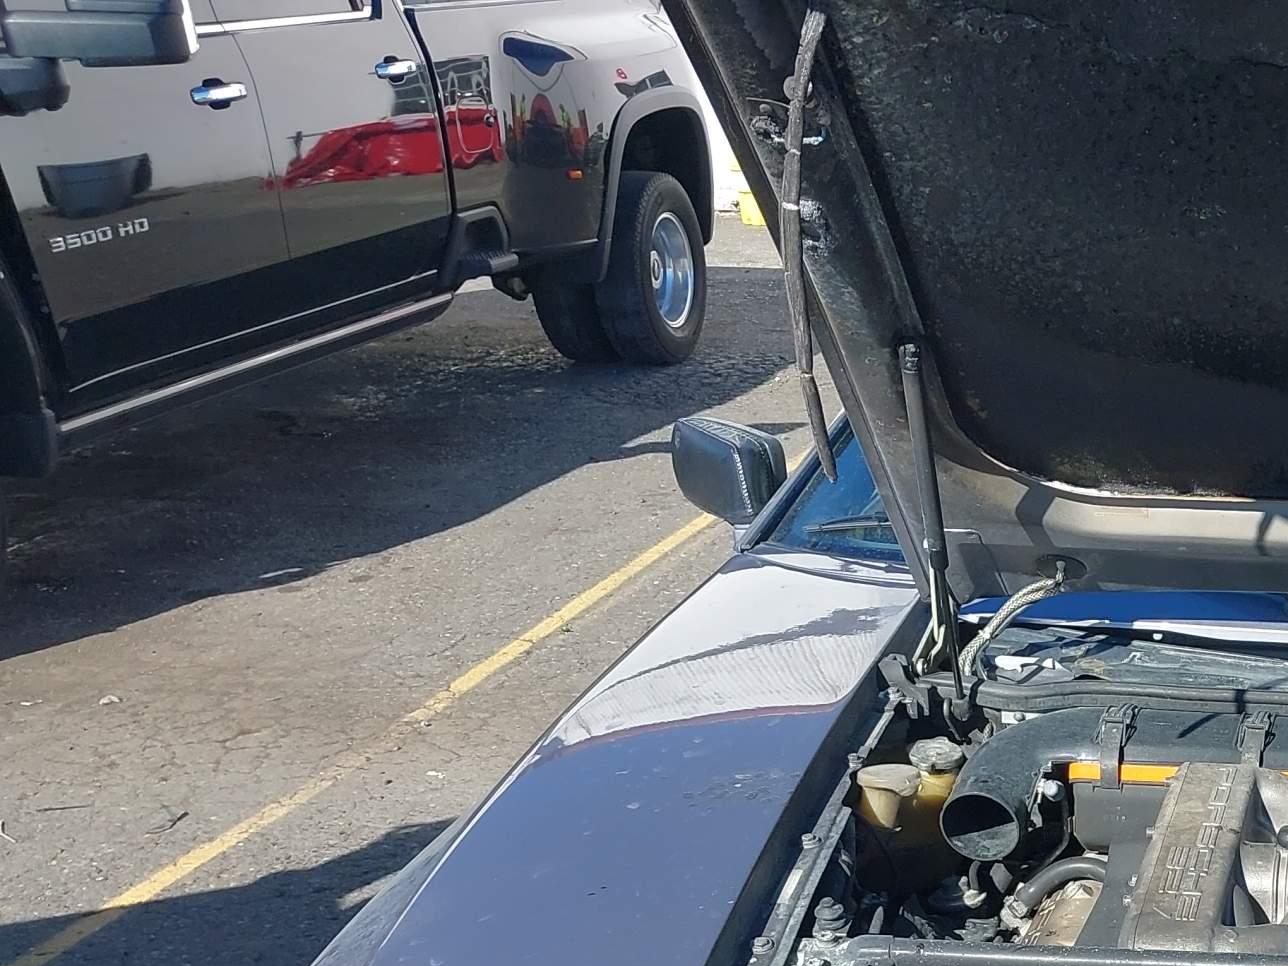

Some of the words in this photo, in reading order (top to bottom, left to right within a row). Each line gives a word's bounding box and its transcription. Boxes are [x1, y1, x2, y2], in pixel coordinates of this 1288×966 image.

[49, 226, 113, 253] 3500
[117, 217, 150, 238] HD
[1173, 766, 1238, 922] PORSCHE
